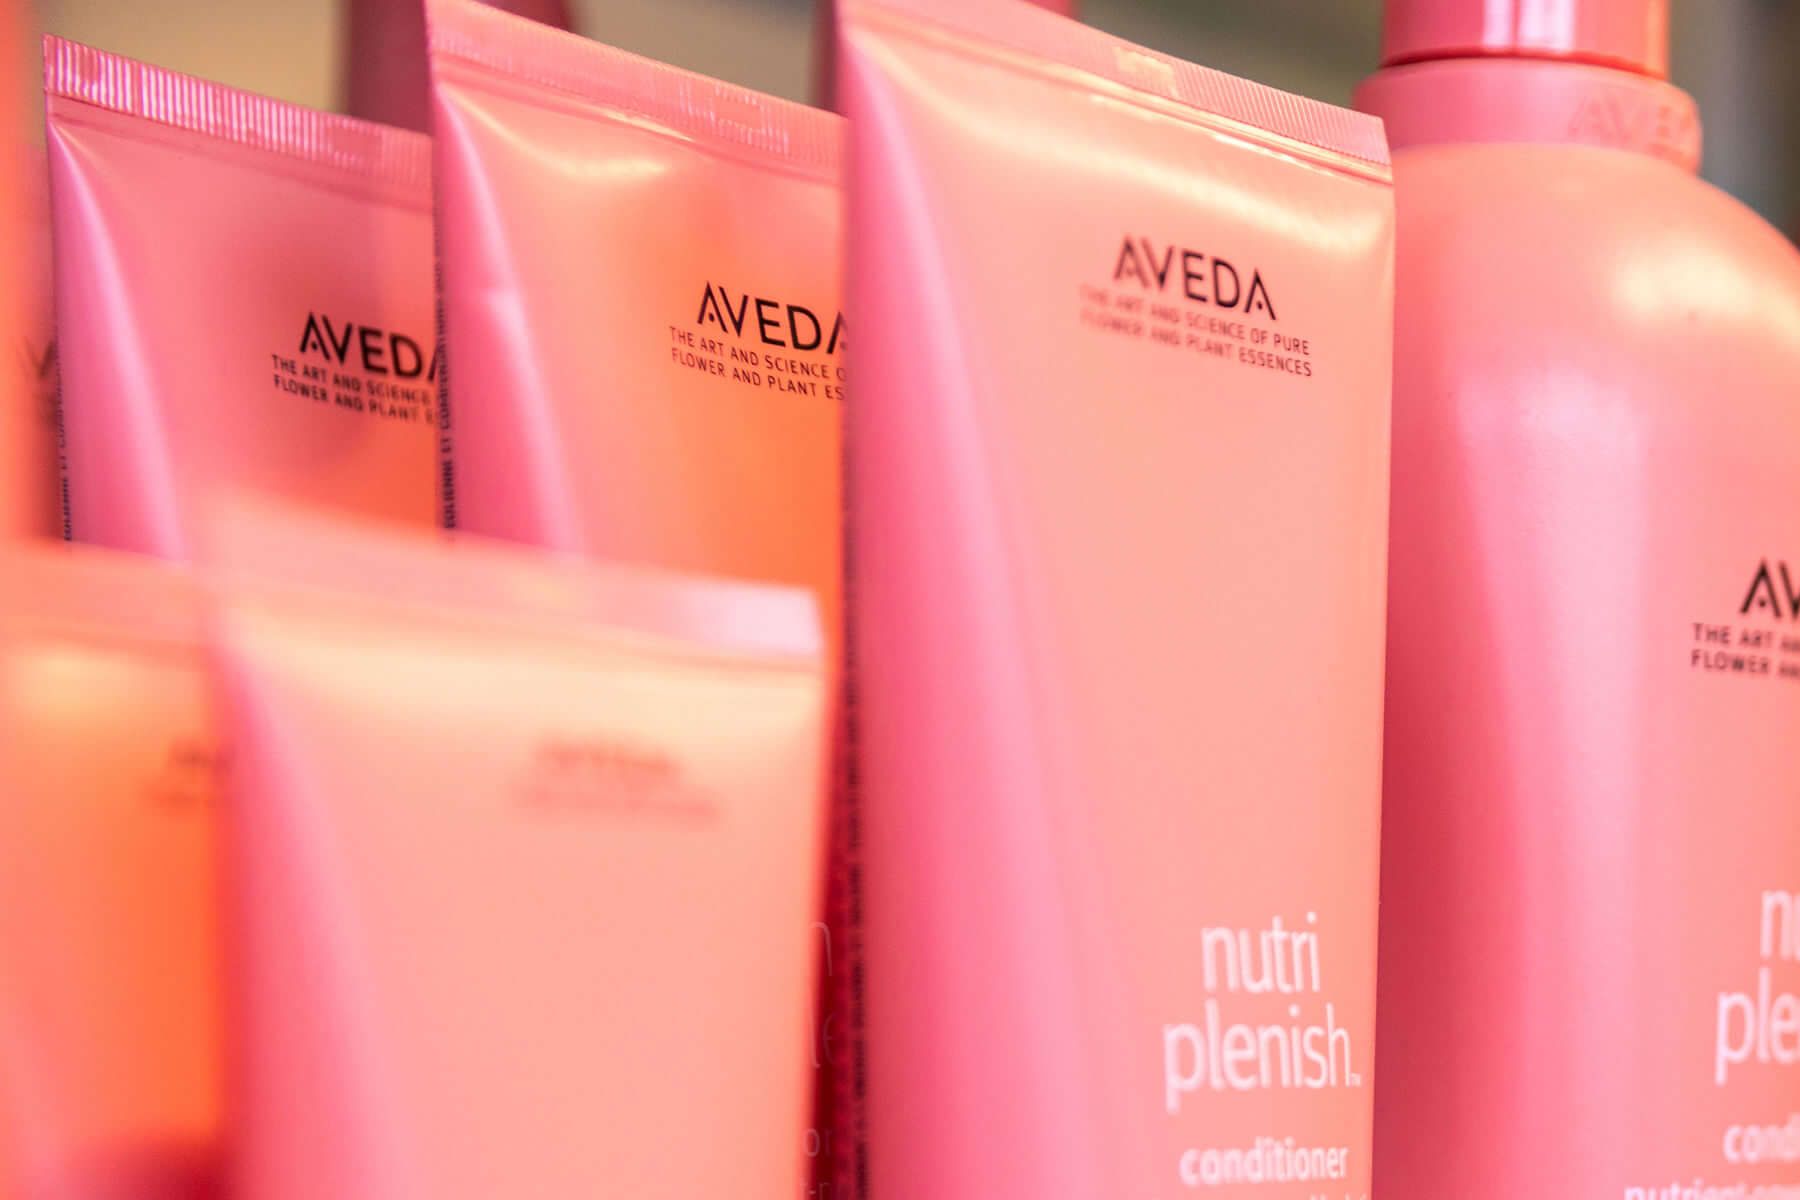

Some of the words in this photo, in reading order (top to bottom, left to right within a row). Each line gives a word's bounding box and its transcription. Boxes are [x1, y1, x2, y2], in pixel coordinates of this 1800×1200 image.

[1113, 235, 1276, 321] AVEDA
[669, 326, 696, 349] THE
[699, 337, 724, 358] ART
[731, 347, 760, 367] AND
[764, 354, 832, 381] SCIENCE
[1186, 311, 1247, 341] SCIENCE
[1250, 327, 1269, 345] OF
[1273, 332, 1311, 356] PURE
[1186, 332, 1234, 362] PLANT
[1238, 346, 1313, 377] ESSENCES
[272, 353, 298, 376] THE
[302, 364, 327, 382] ART
[333, 373, 362, 393] AND
[273, 374, 329, 402] FLOWER
[335, 391, 364, 412] AND
[671, 347, 728, 378] FLOWER
[732, 367, 762, 387] AND
[767, 374, 817, 399] PLANT
[1691, 622, 1731, 645] THE
[1201, 910, 1321, 994] nutri
[1179, 1136, 1348, 1186] conditioner
